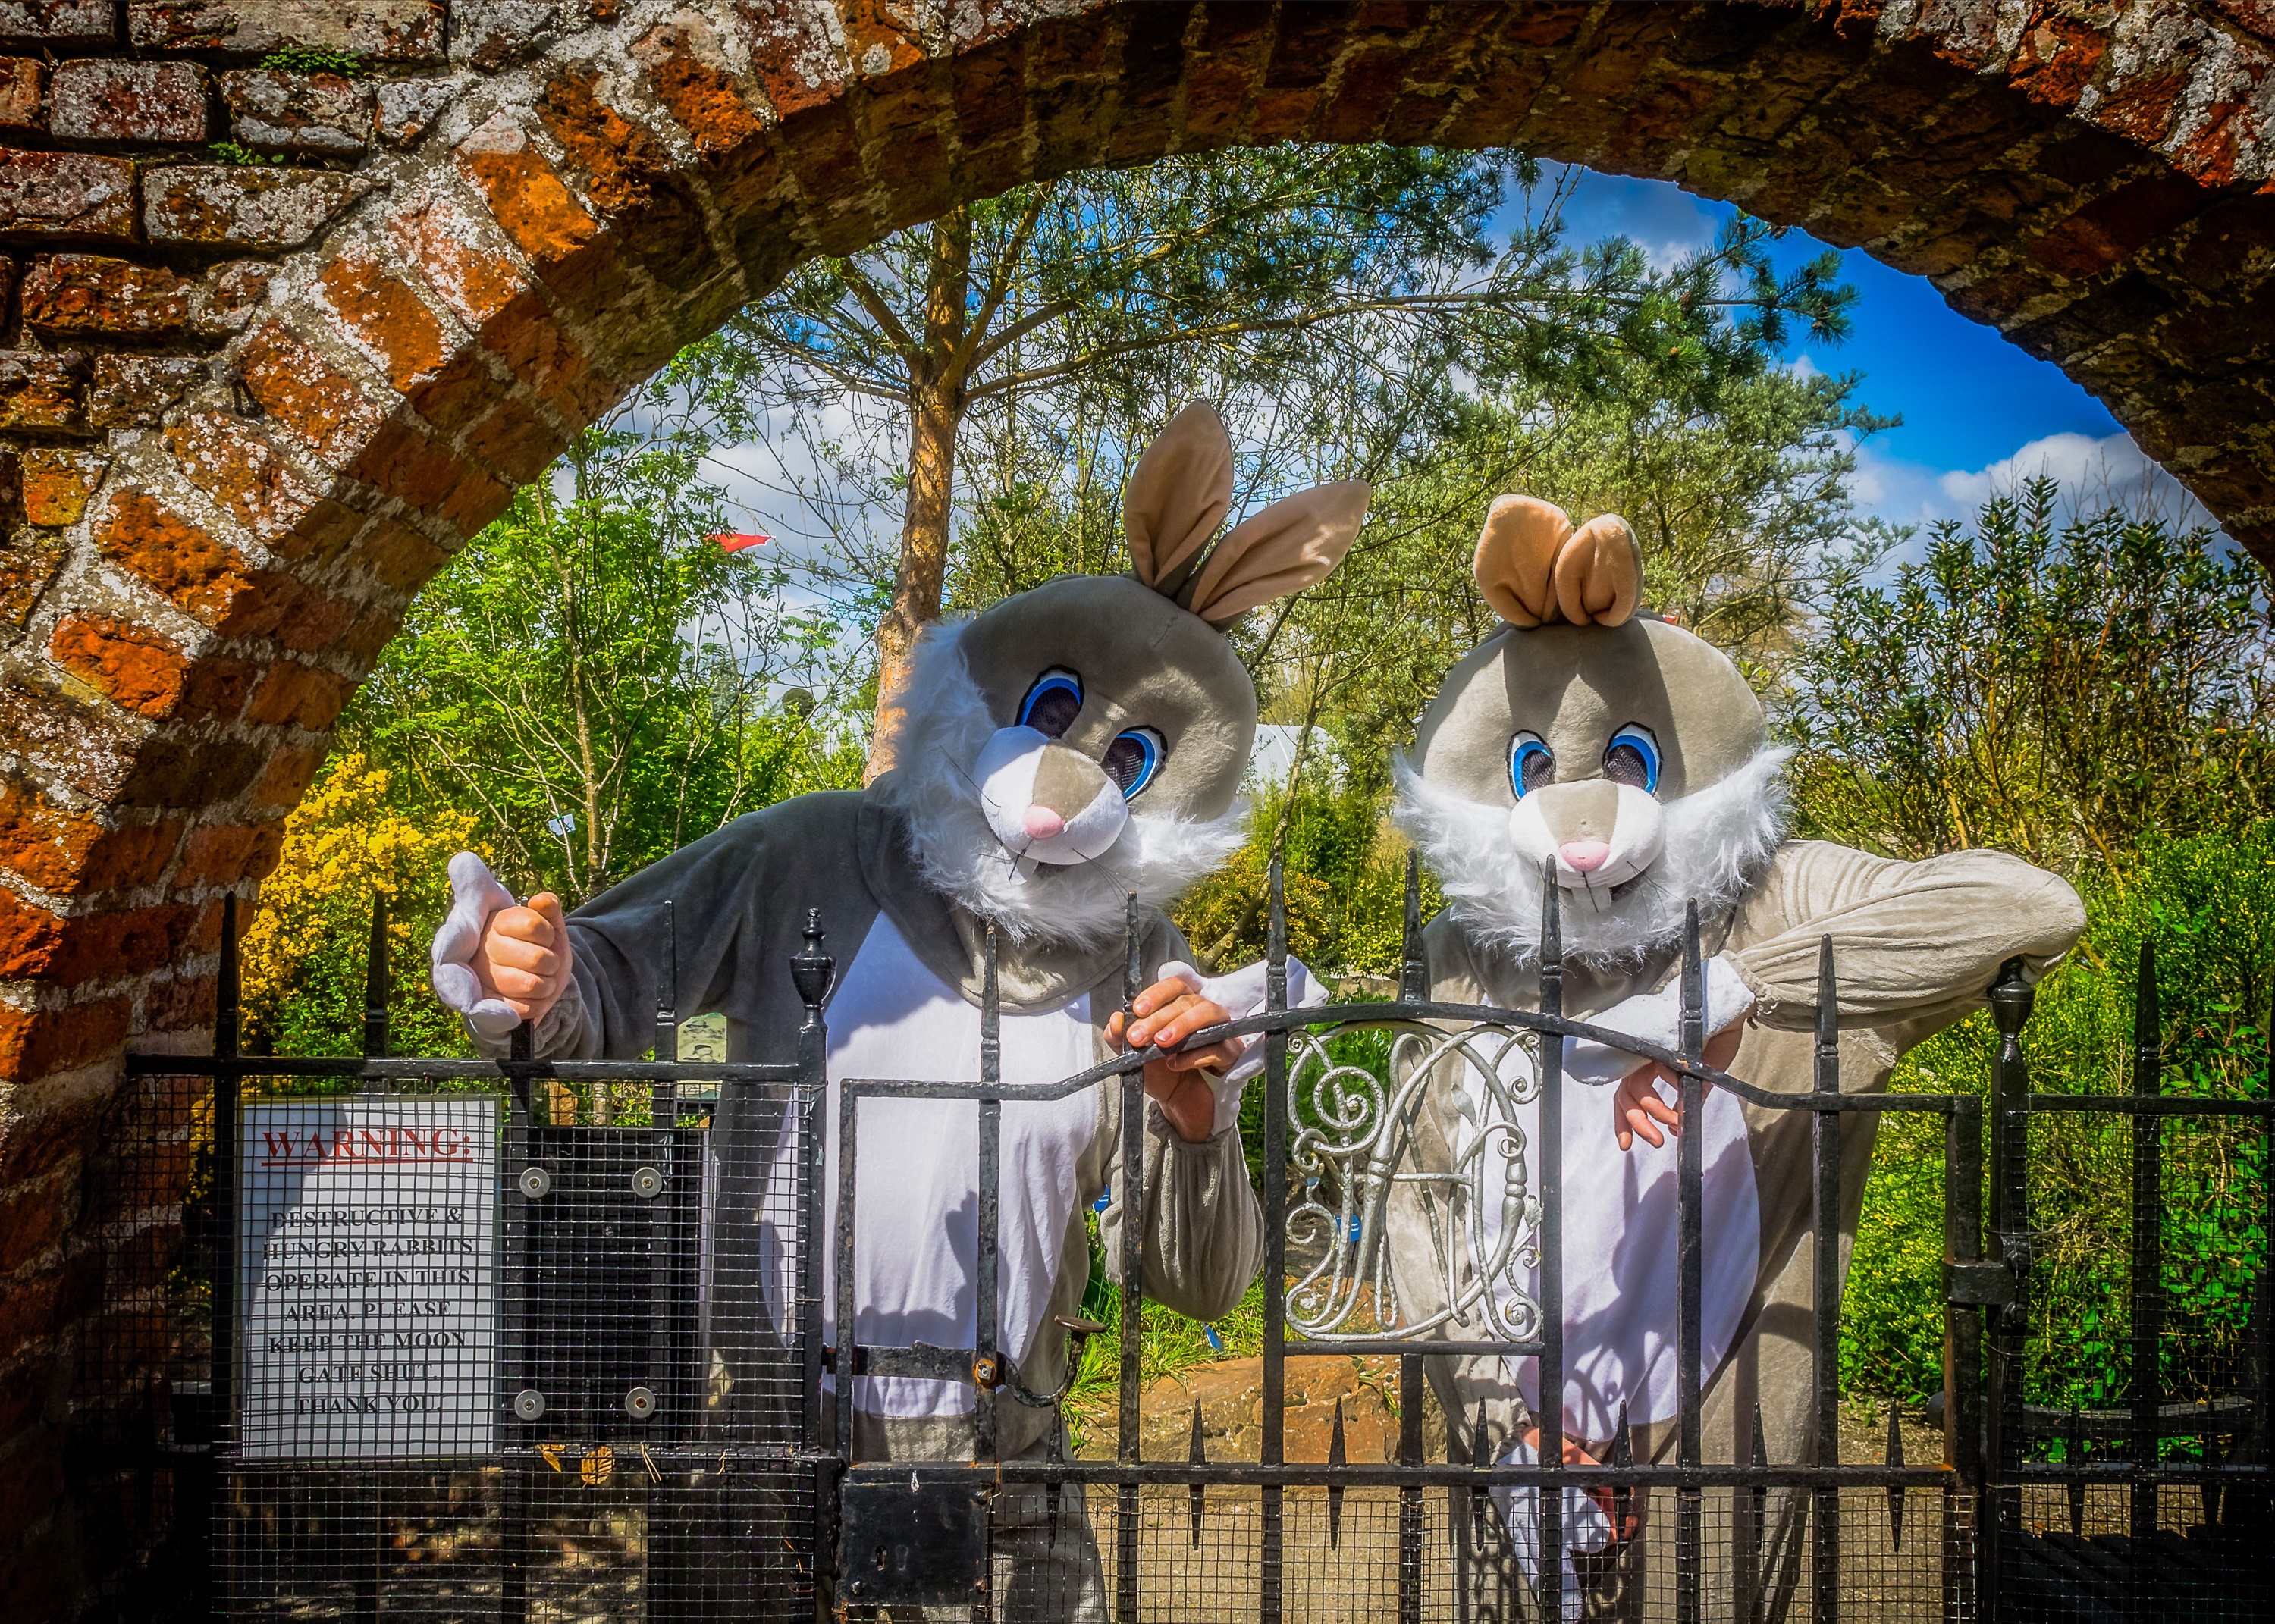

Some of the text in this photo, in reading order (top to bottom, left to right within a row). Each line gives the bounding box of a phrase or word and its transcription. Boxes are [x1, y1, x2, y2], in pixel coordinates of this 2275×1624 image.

[262, 1128, 470, 1158] WARNING:
[271, 1207, 463, 1228] DESTRUCTIVE &
[263, 1238, 472, 1260] HUNGRY RABBITS
[266, 1269, 470, 1291] OPERATE IN THIS
[284, 1301, 452, 1321] AREA. PLEASE
[268, 1332, 466, 1353] KEEP THE MOON
[298, 1364, 438, 1384] GATE SHUT.
[295, 1396, 379, 1415] THANK
